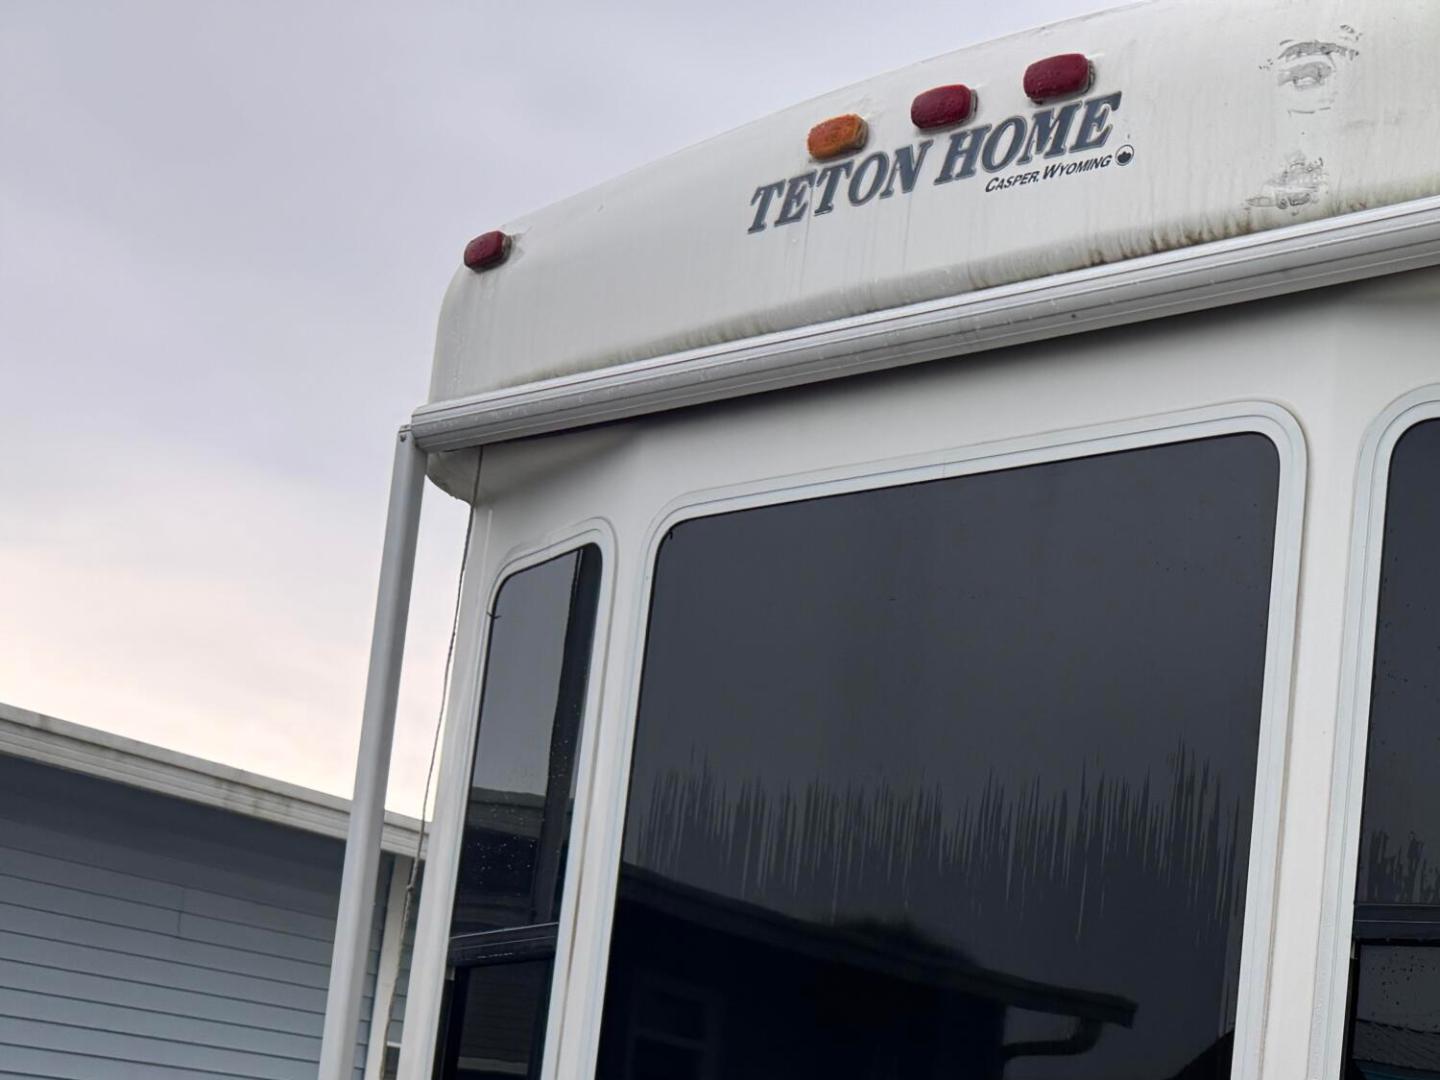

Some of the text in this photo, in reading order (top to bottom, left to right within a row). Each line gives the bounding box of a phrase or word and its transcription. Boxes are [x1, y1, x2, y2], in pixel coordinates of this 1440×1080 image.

[747, 90, 1123, 235] TETON HOME
[1042, 153, 1113, 181] WYOMING
